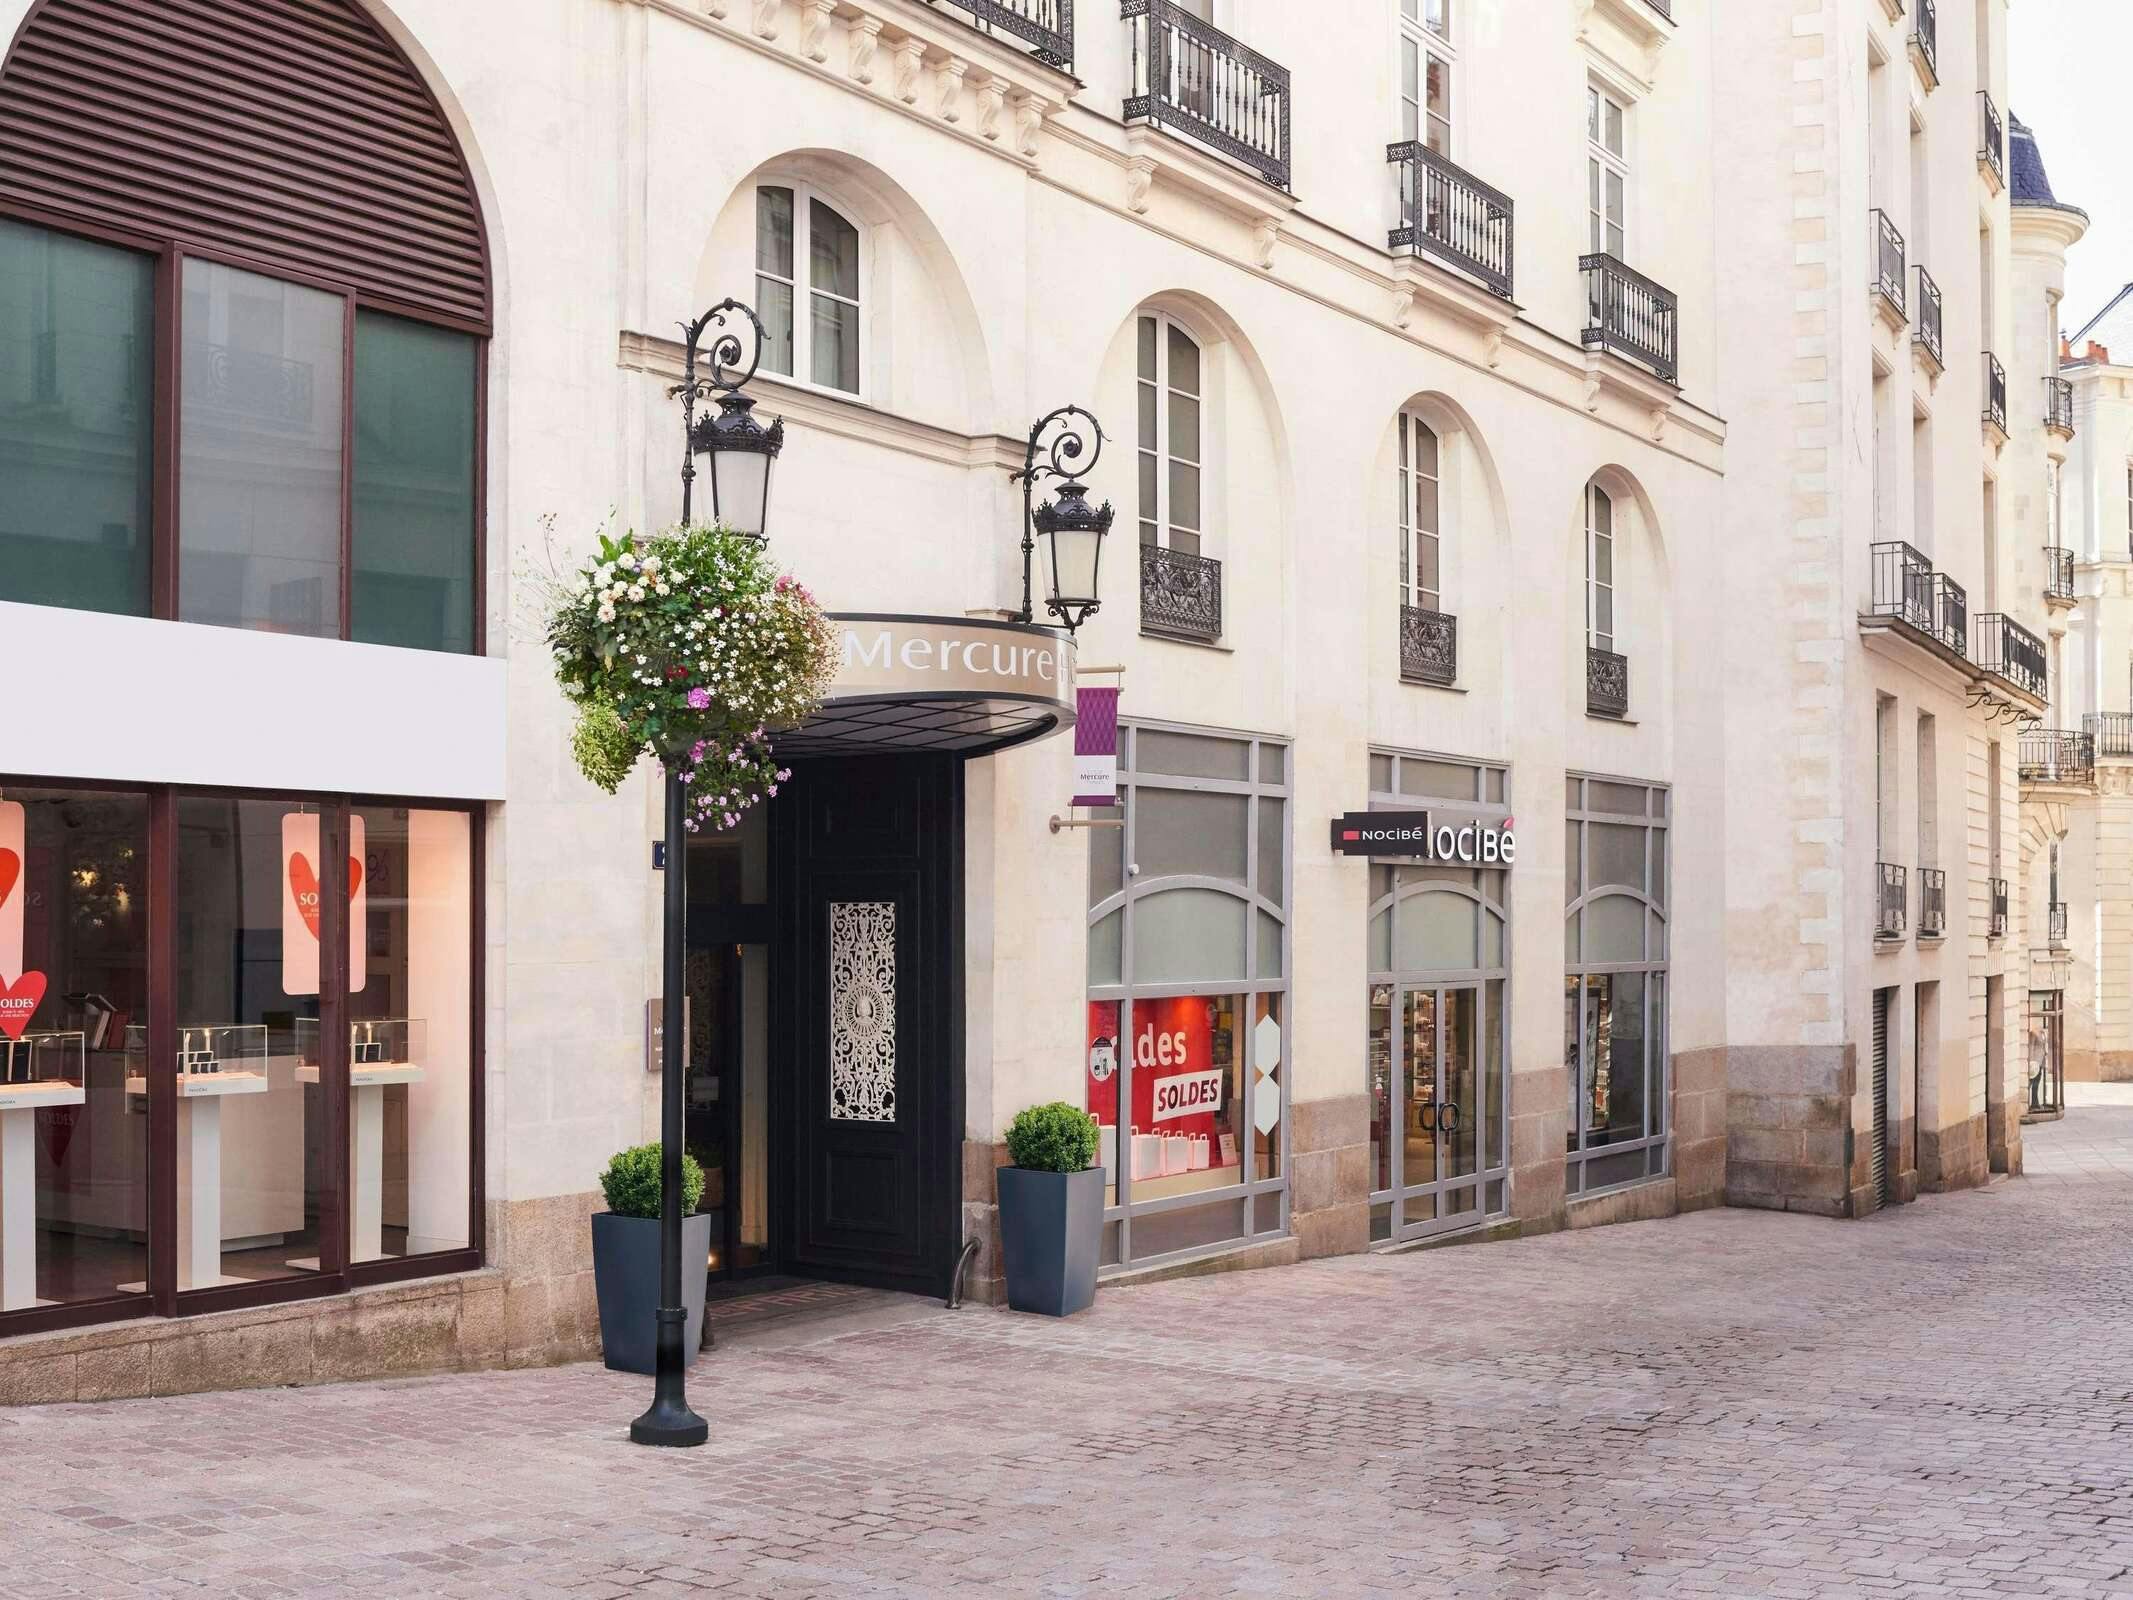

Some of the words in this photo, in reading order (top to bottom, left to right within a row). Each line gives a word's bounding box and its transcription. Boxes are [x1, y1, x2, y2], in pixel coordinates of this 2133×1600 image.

[842, 629, 1054, 682] Mercure
[0, 998, 35, 1009] OLDES
[1157, 1077, 1219, 1113] SOLDES
